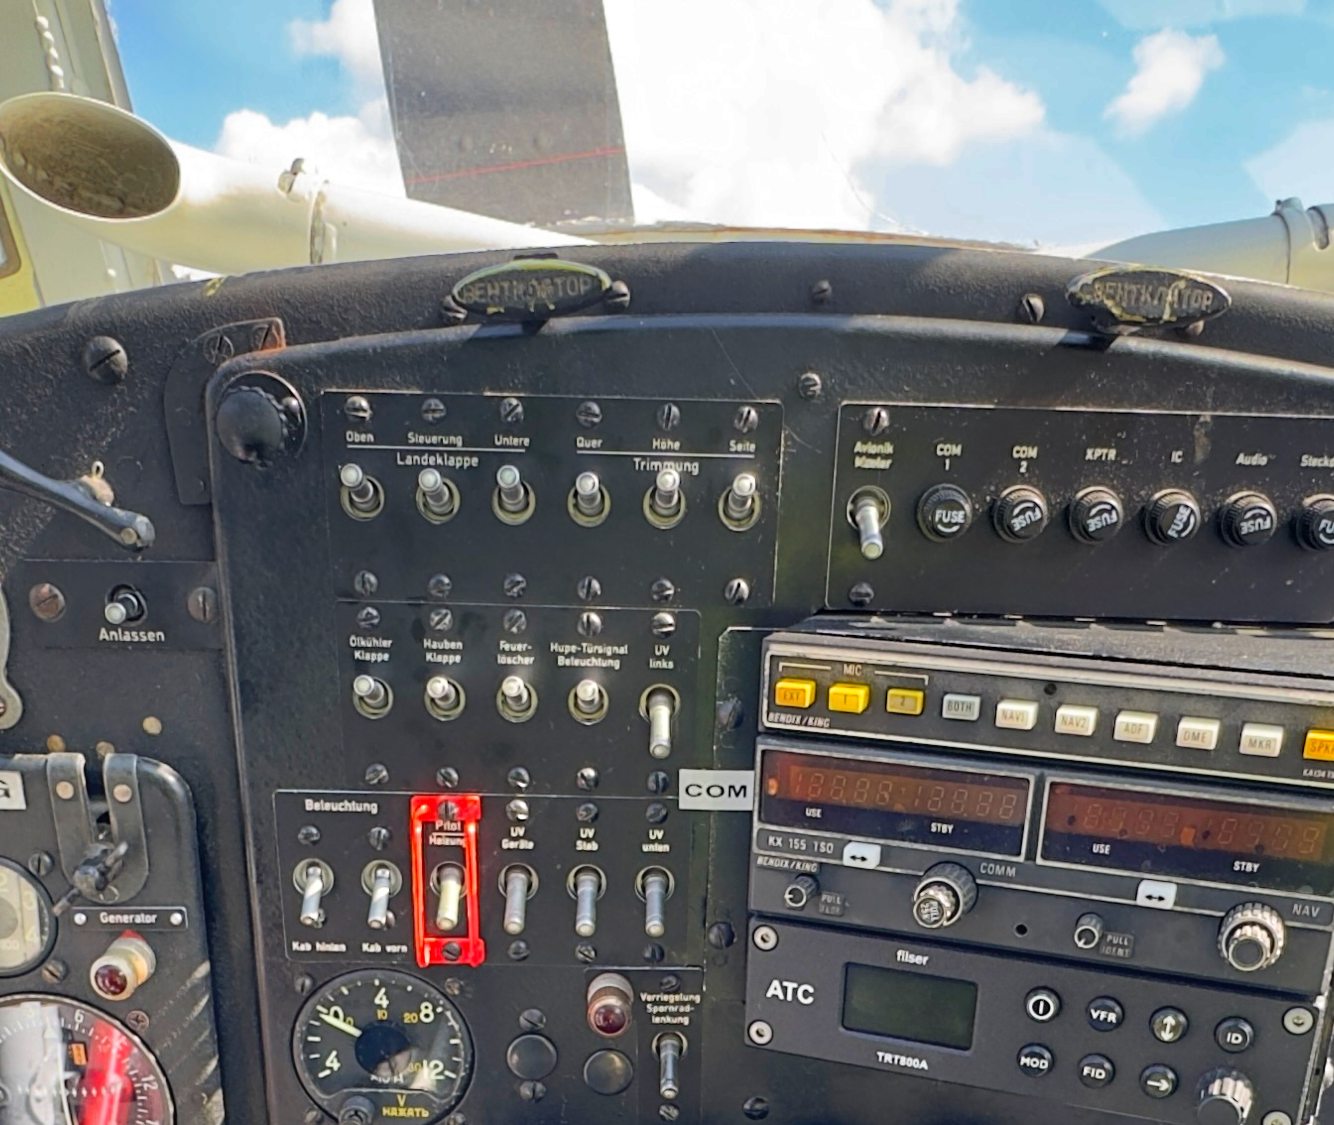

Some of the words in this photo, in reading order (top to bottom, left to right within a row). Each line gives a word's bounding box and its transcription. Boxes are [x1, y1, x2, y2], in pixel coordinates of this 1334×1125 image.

[346, 431, 374, 443] Oben
[408, 433, 462, 447] Steuerung
[495, 434, 530, 447] Untere
[576, 436, 603, 450] Quer
[652, 438, 680, 450] Höhe
[729, 440, 756, 452] Seite
[854, 441, 894, 455] Avionik
[936, 444, 961, 457] COM
[1013, 446, 1037, 459] COM
[1086, 448, 1116, 462] XPTR
[1237, 452, 1267, 466] Audio
[397, 453, 478, 469] Landeklappe
[634, 459, 698, 475] Trimmung
[935, 510, 965, 523] FUSE
[1087, 511, 1119, 531] FUSE
[1168, 505, 1190, 538] FUSE
[1241, 516, 1271, 535] FUSE
[99, 627, 165, 643] Anlassen
[424, 639, 462, 651] Hauben
[499, 641, 532, 653] Feuer-
[655, 645, 669, 657] UV
[354, 650, 389, 663] Klappe
[426, 652, 461, 665] Klappe
[497, 654, 534, 666] löscher
[558, 656, 620, 670] Beleuchtung
[649, 657, 673, 669] links
[844, 664, 861, 676] MIC
[783, 691, 800, 701] EXT
[947, 702, 972, 714] BOTH
[768, 712, 830, 728] BENDIX/KING
[1060, 716, 1086, 728] NAV2
[1124, 724, 1143, 735] ADF
[1183, 730, 1206, 743] DME
[1248, 738, 1271, 749] MKR
[685, 783, 747, 798] COM
[306, 799, 377, 814] Beleuchtung
[806, 808, 821, 818] USE
[511, 827, 525, 838] UV
[580, 828, 594, 839] UV
[649, 829, 663, 840] UV
[931, 822, 954, 834] STBY
[502, 839, 534, 850] Geräte
[643, 842, 670, 853] unten
[768, 836, 783, 848] KX
[789, 838, 806, 850] 155
[1093, 844, 1110, 855] USE
[757, 856, 818, 872] BENDIX/KING
[980, 863, 1016, 878] COMM
[1234, 861, 1259, 873] STBY
[1292, 904, 1319, 918] NAV
[100, 913, 157, 924] Generator
[1107, 934, 1129, 945] PULL
[292, 941, 312, 952] Kab
[315, 941, 346, 952] hinten
[362, 942, 382, 953] Kab
[385, 943, 408, 953] vorn
[896, 950, 929, 966] filser
[640, 992, 700, 1005] Verriegelung
[766, 980, 814, 1004] ATC
[646, 1003, 694, 1015] Spornrad-
[652, 1014, 689, 1025] lenkung
[1090, 1009, 1117, 1024] VFR
[1226, 1032, 1243, 1044] ID
[877, 1052, 928, 1070] TRT800A
[1020, 1057, 1048, 1070] MOD
[1083, 1066, 1105, 1079] FID
[382, 1107, 429, 1117] НАЖАТЬ
